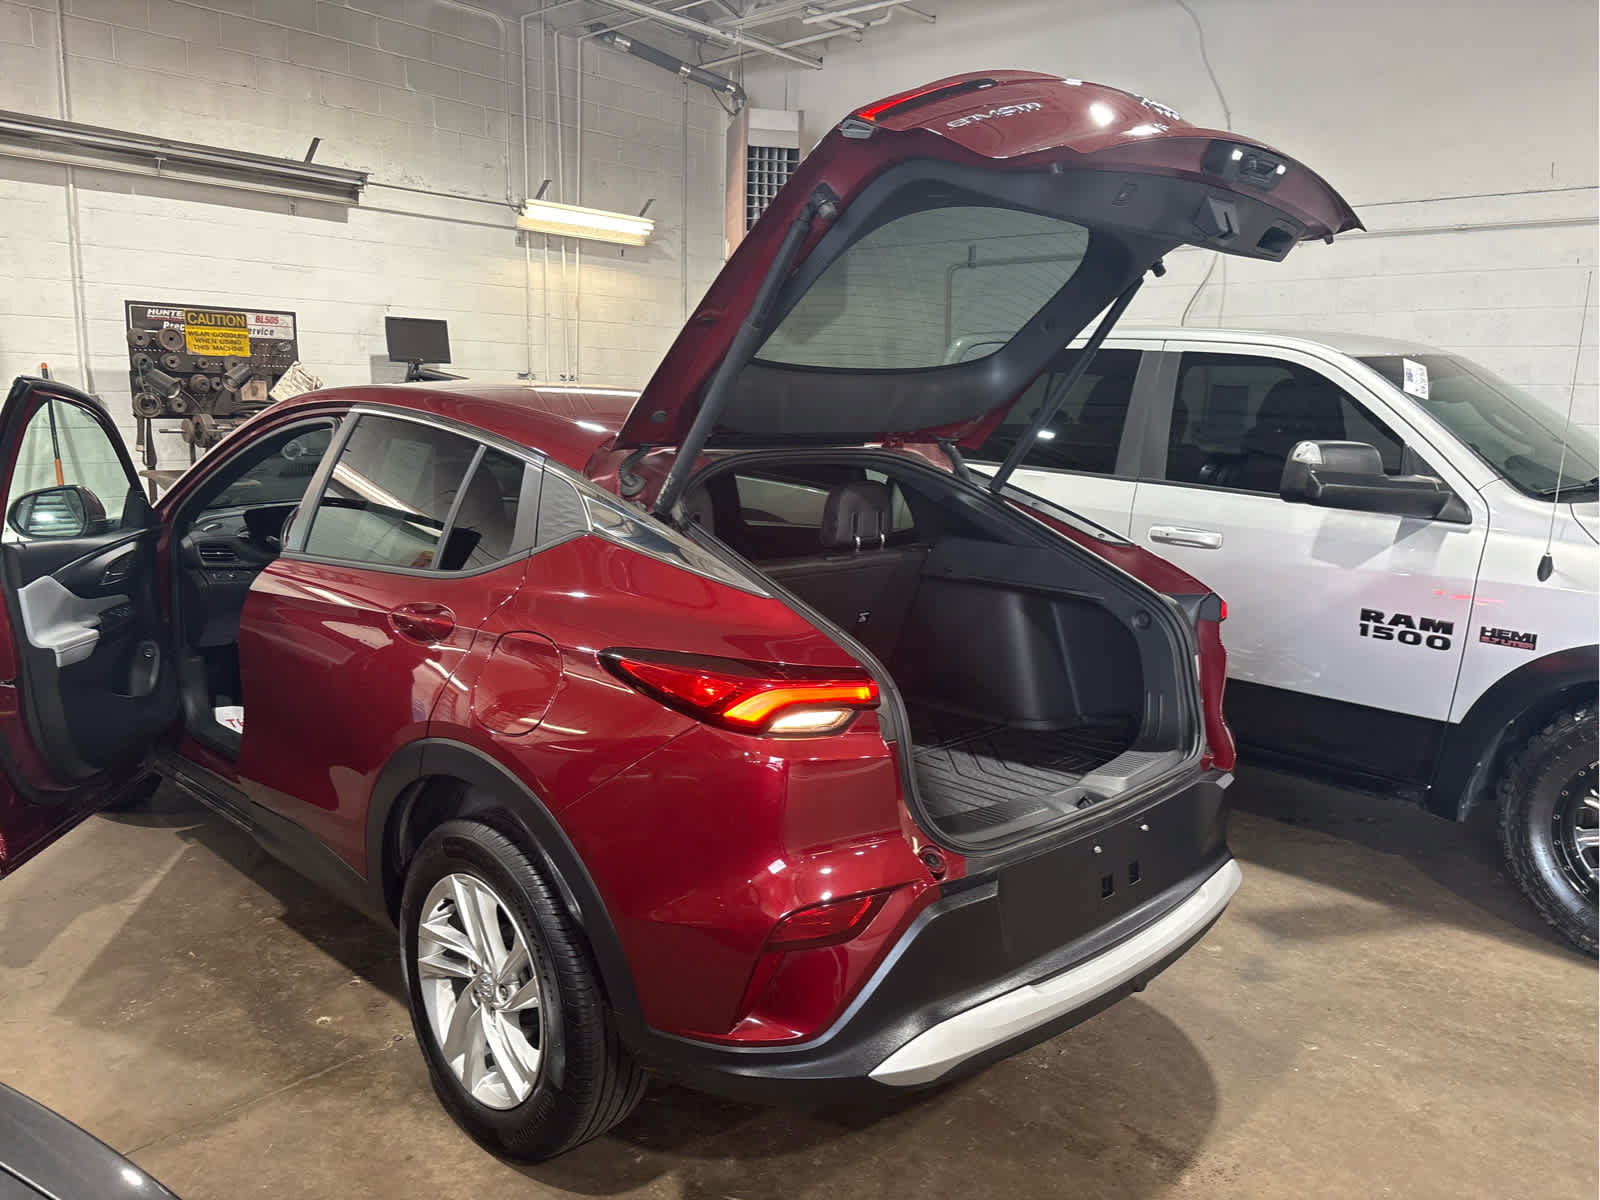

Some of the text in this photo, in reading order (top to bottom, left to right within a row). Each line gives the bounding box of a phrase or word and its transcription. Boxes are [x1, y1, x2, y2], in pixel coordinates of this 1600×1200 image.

[187, 312, 246, 327] CAUTION
[1360, 608, 1454, 635] RAM
[1359, 623, 1451, 651] 1500
[1480, 626, 1537, 644] HEMI
